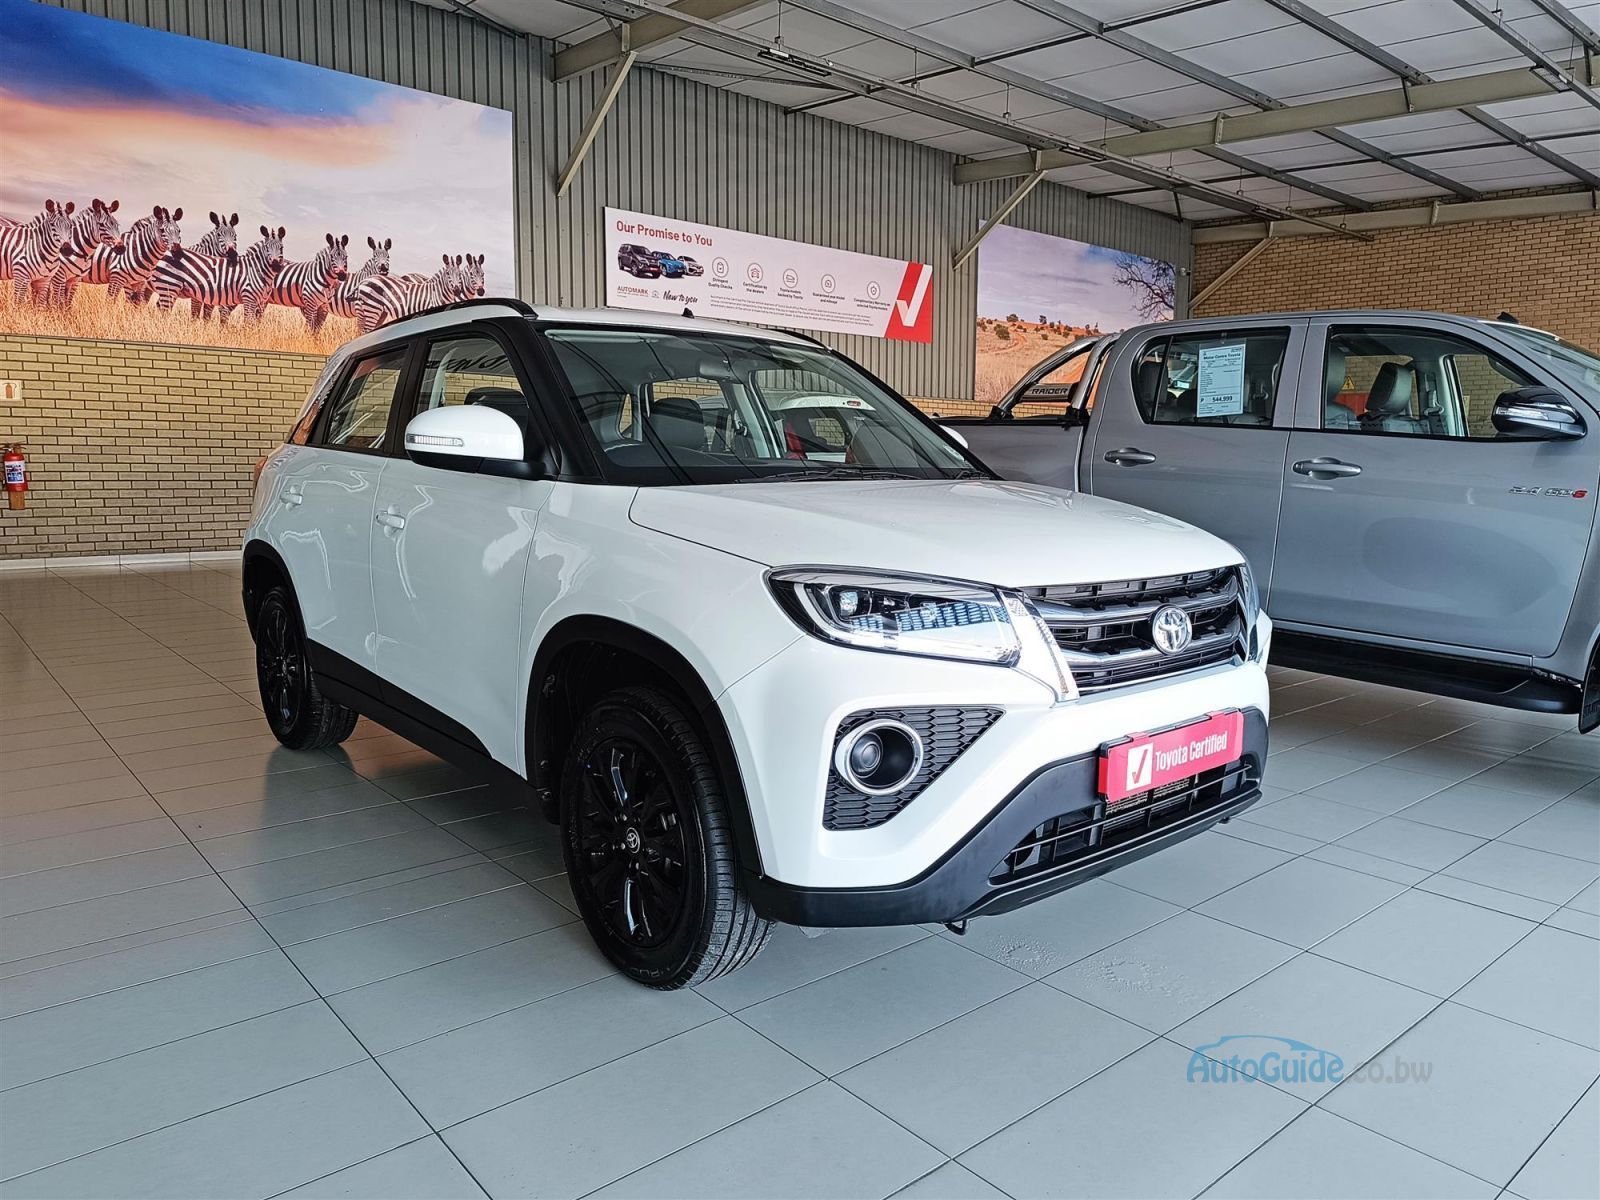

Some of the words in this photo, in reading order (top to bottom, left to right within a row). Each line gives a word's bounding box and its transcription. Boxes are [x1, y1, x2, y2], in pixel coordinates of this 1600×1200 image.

[616, 220, 635, 234] Our
[637, 223, 680, 241] Promise
[682, 232, 692, 243] to
[694, 233, 713, 247] You
[617, 285, 649, 295] AUTOMARK
[662, 290, 678, 301] New
[678, 293, 685, 302] to
[685, 296, 699, 306] you
[1155, 744, 1189, 772] Toyota
[1189, 731, 1228, 761] Certified
